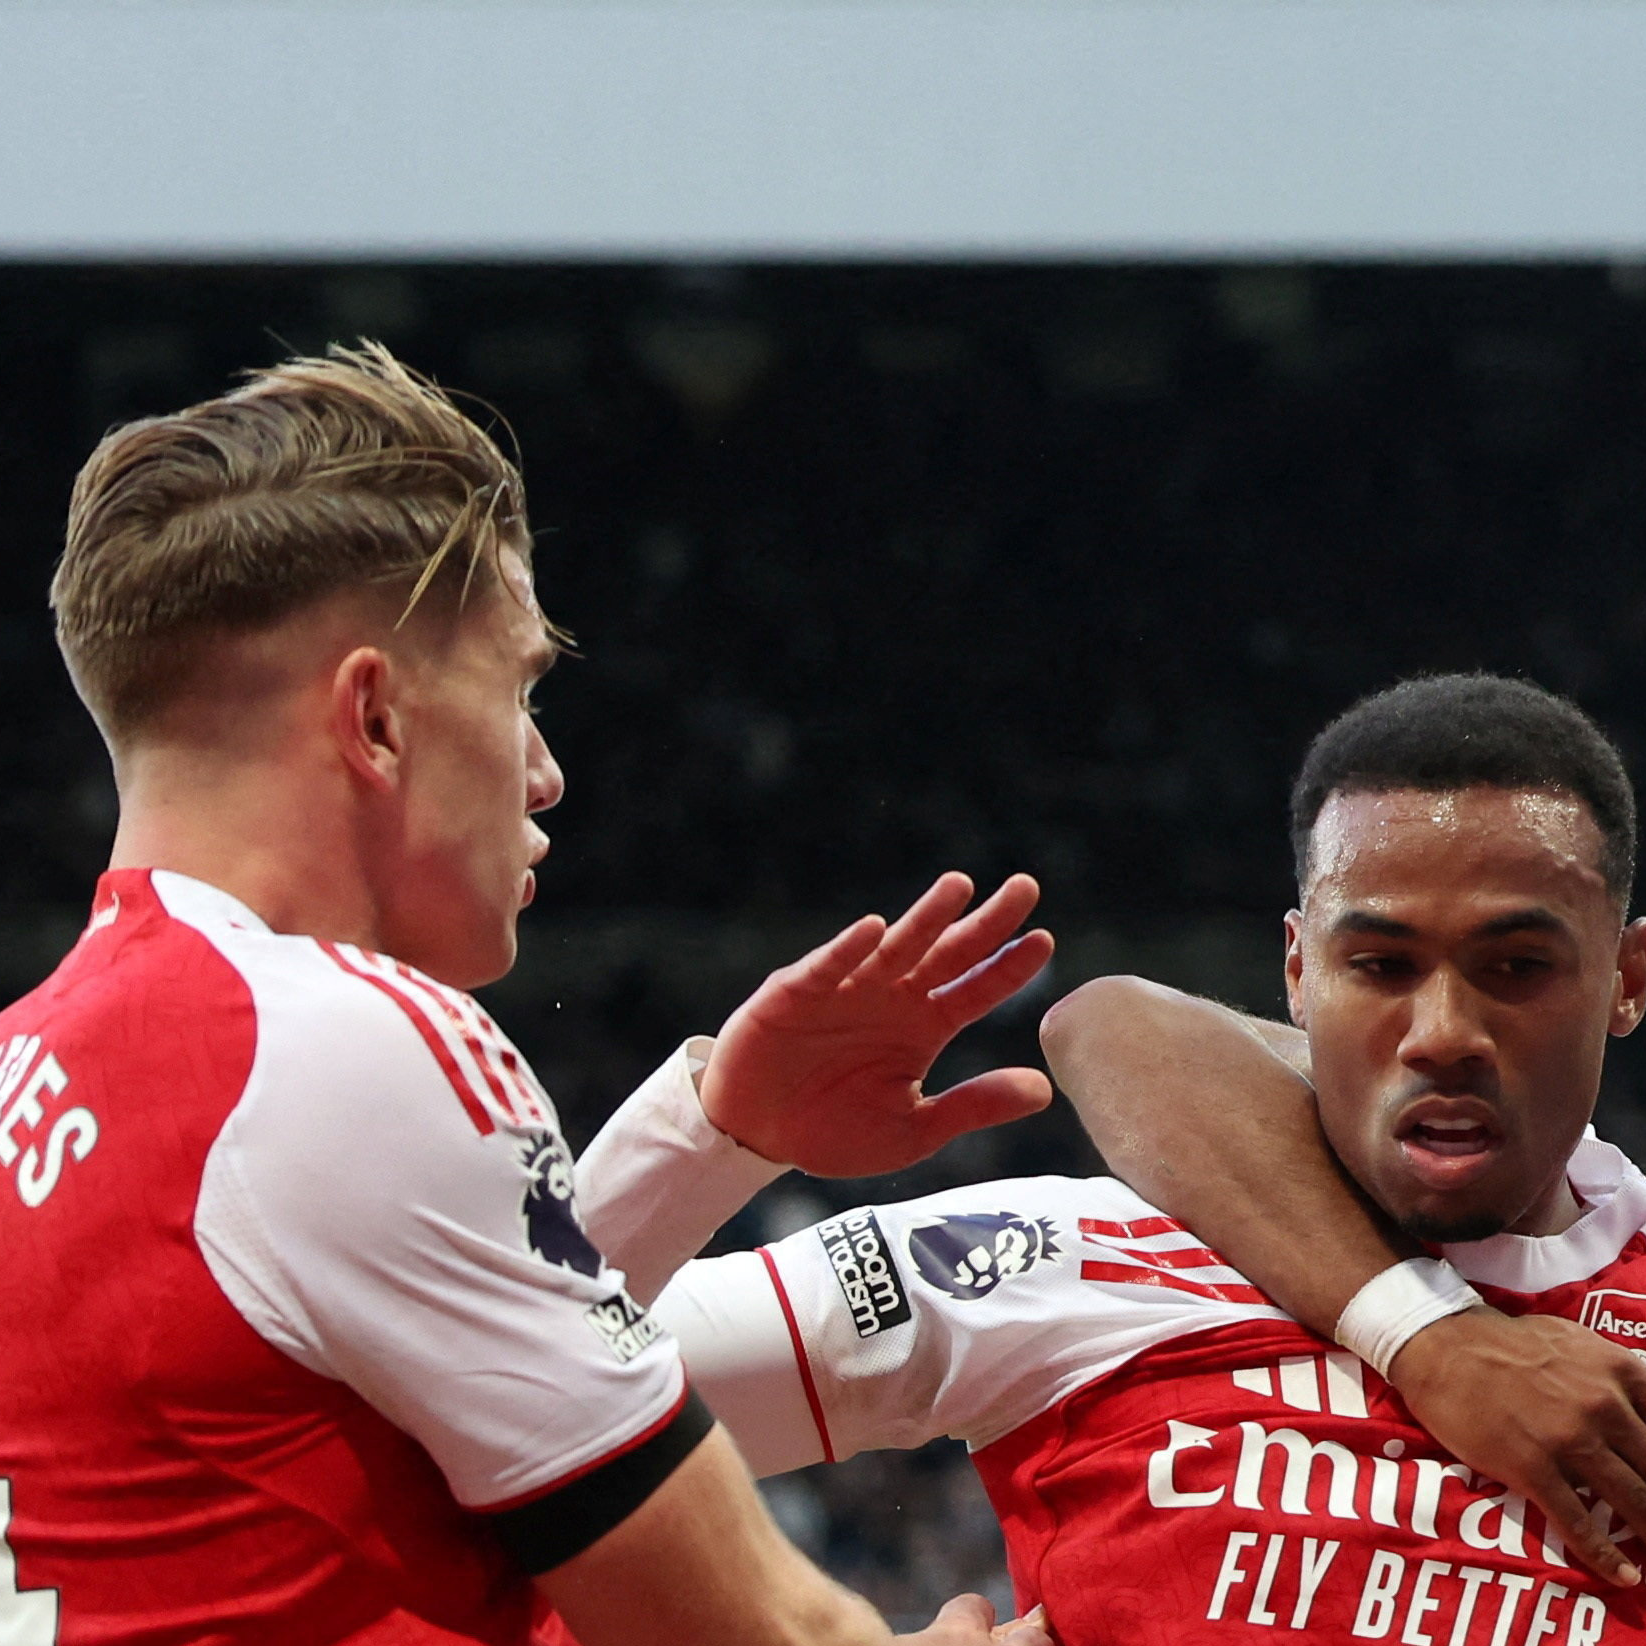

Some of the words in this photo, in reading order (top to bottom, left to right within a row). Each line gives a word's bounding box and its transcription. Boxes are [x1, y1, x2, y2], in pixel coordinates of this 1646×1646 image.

[827, 1238, 881, 1337] racism
[850, 1227, 900, 1314] room
[1205, 1530, 1341, 1631] FLY
